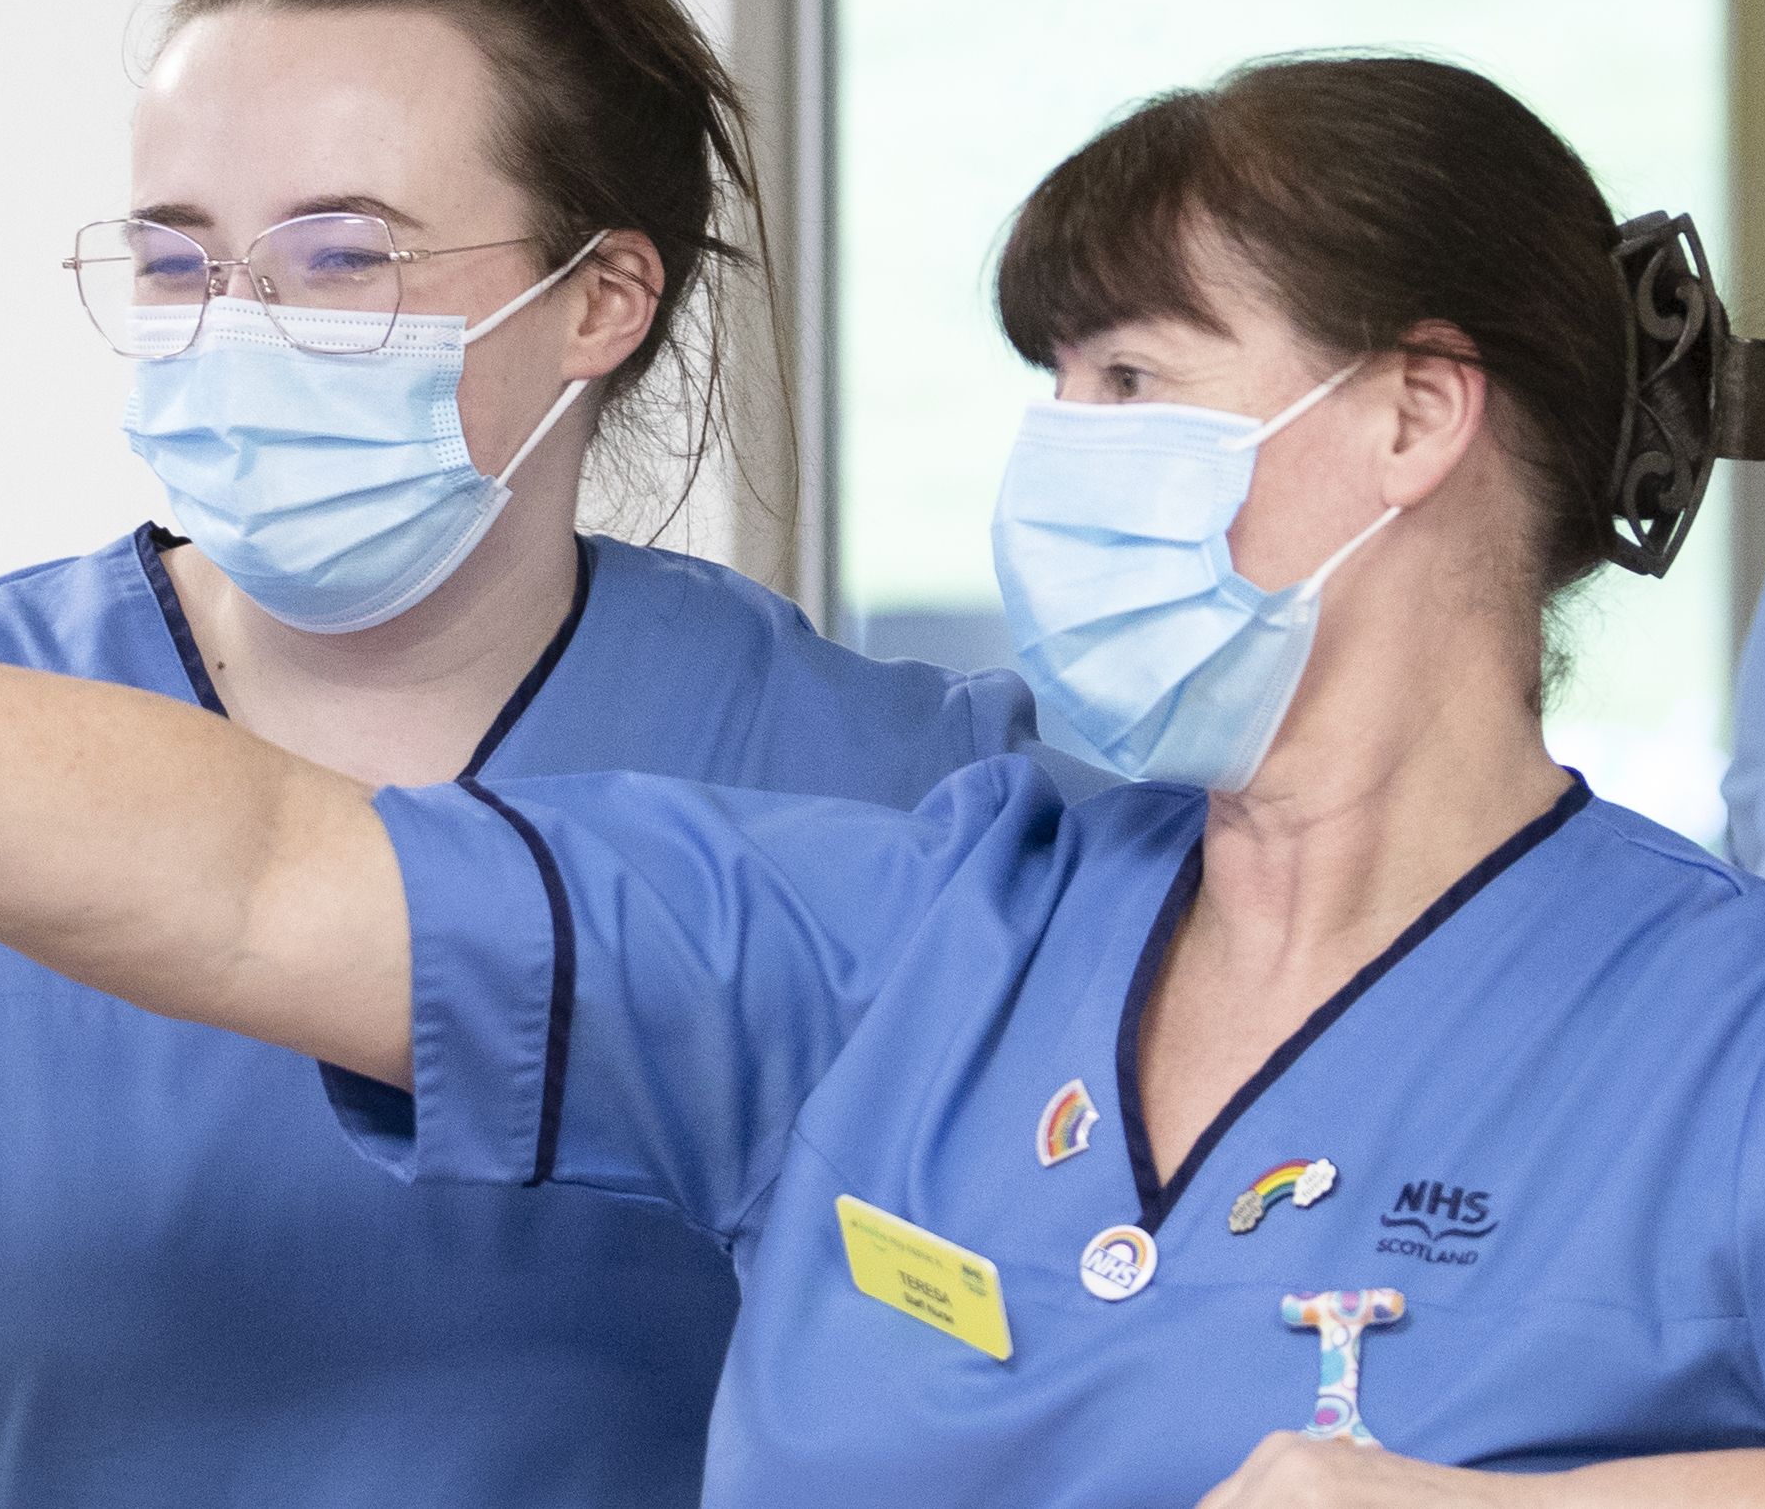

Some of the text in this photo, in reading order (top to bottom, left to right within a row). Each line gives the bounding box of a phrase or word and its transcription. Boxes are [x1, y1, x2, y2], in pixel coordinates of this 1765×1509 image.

[1393, 1179, 1492, 1224] NHS
[1085, 1248, 1139, 1289] NHS
[1376, 1238, 1479, 1266] SCOTLAND
[898, 1268, 953, 1307] TERESA
